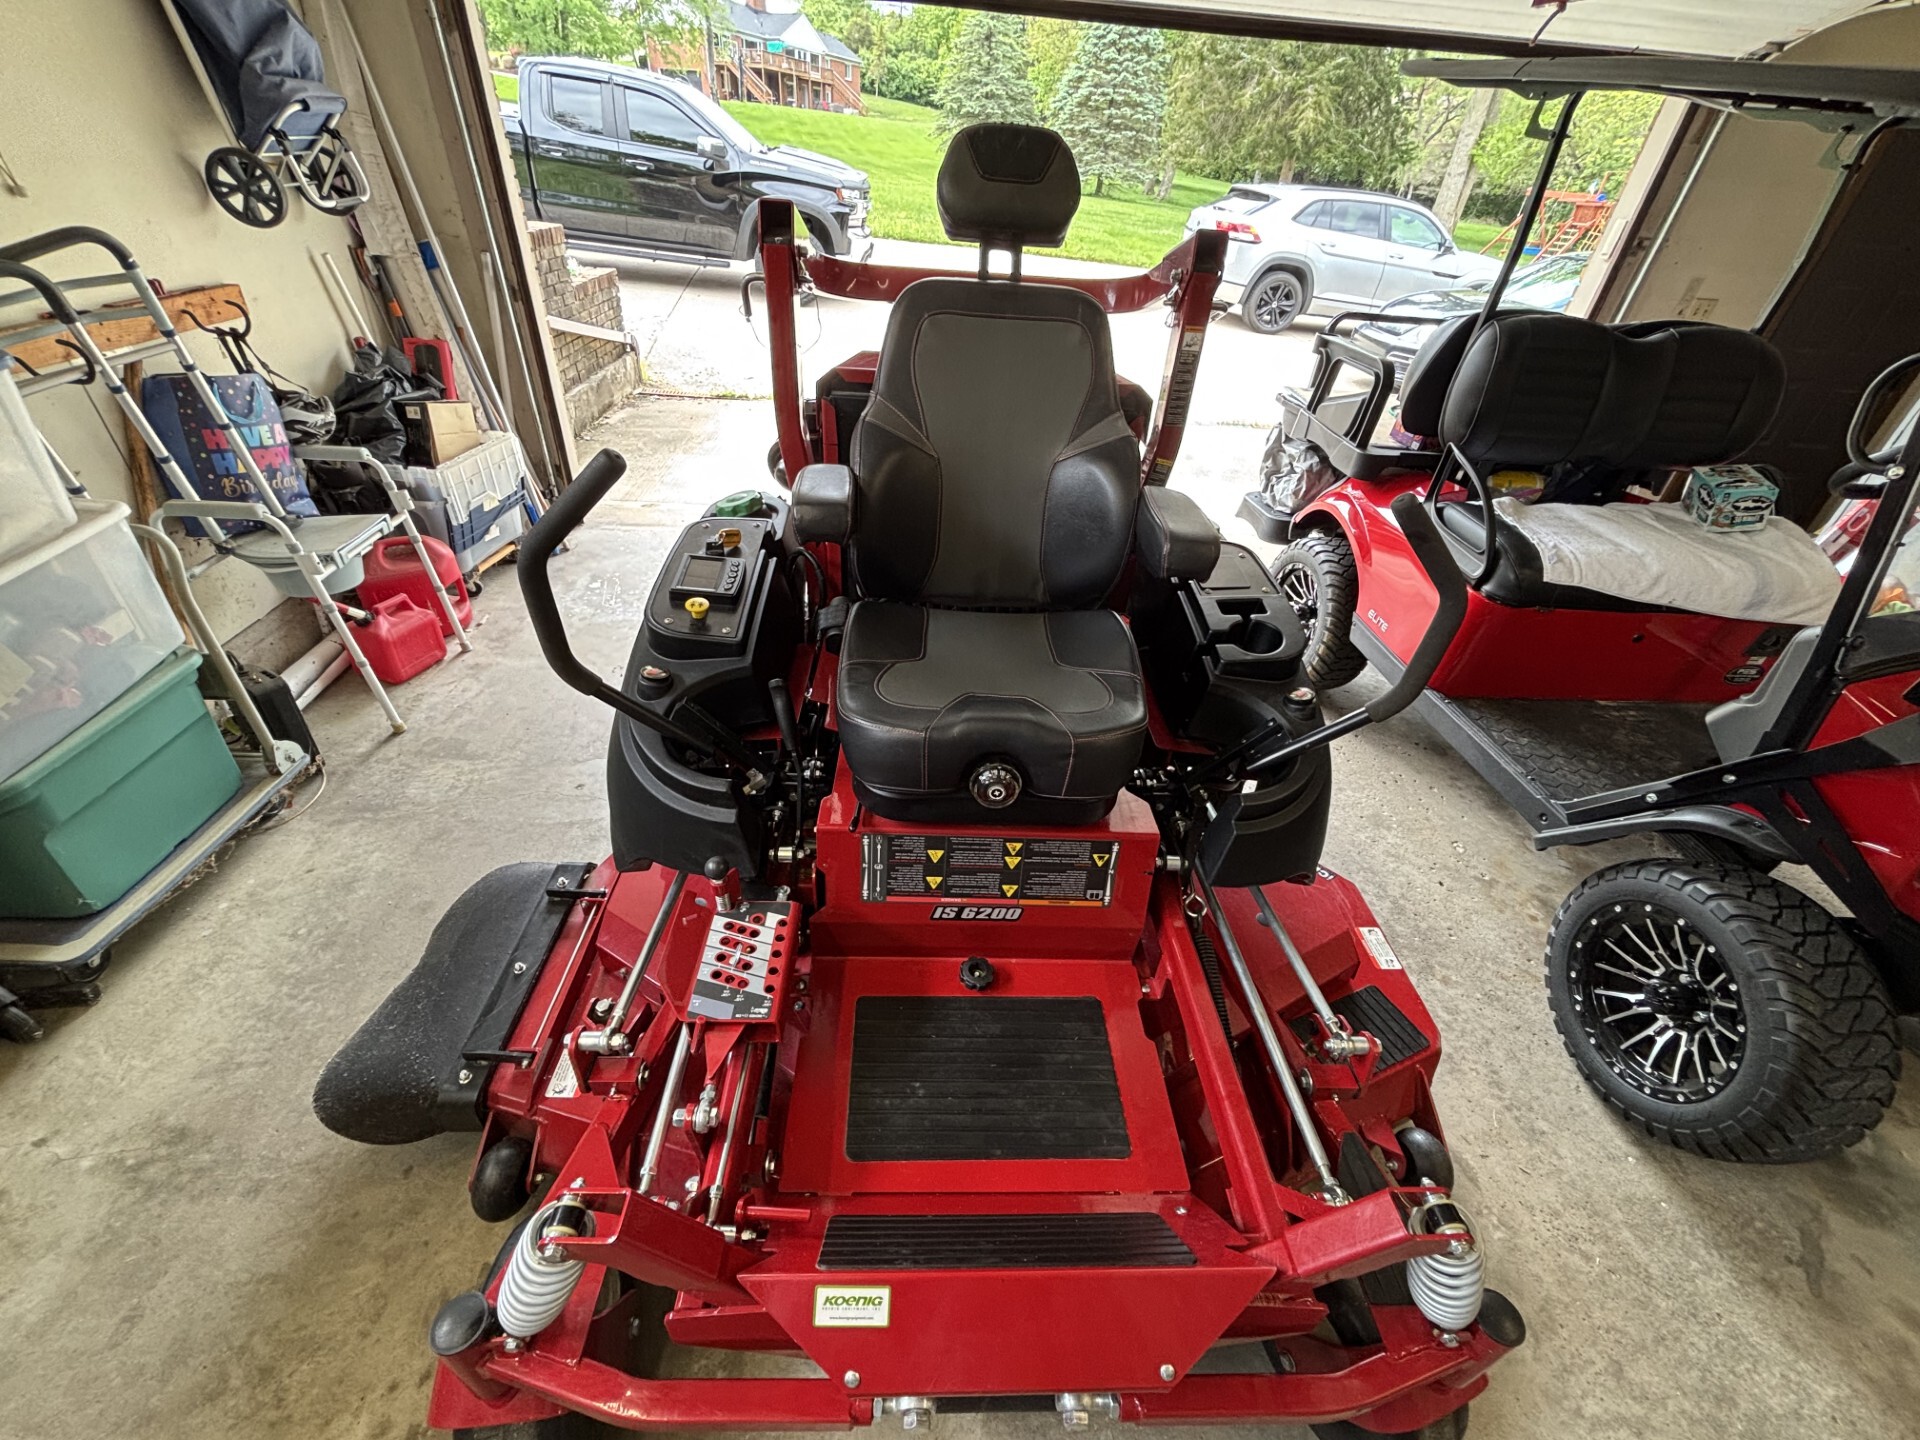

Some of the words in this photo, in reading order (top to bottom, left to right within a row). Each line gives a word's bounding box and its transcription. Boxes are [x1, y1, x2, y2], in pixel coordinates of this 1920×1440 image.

[201, 424, 275, 450] HVE
[273, 423, 289, 445] A
[1367, 609, 1389, 633] ELITE
[932, 906, 958, 919] IS
[960, 907, 1022, 920] 6200
